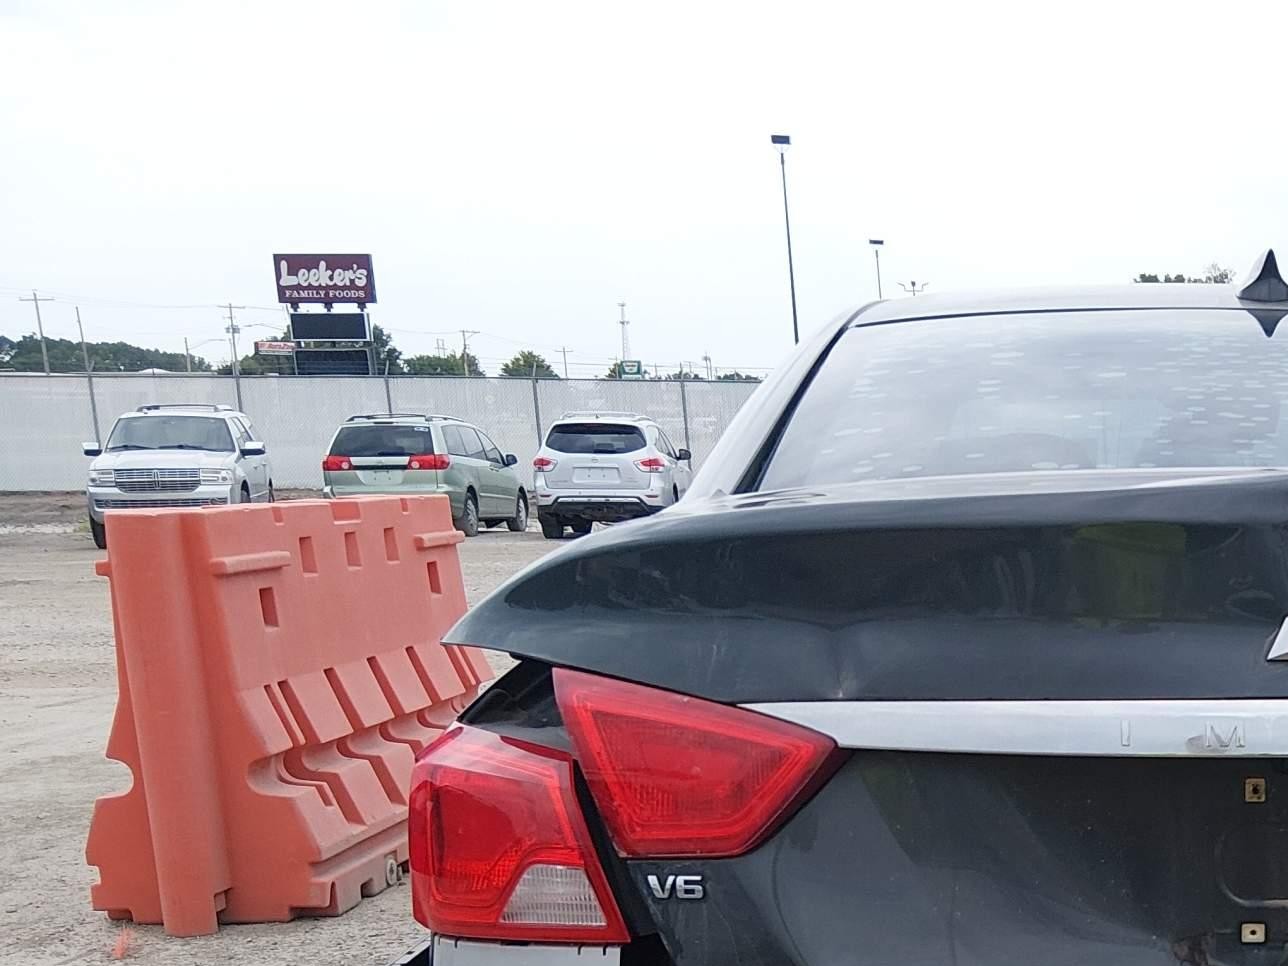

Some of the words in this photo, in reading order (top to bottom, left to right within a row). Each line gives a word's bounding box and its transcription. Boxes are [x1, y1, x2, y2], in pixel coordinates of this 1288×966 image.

[279, 260, 367, 286] Leeker's
[285, 290, 326, 298] FAMILY
[328, 290, 365, 298] FOODS
[647, 875, 704, 899] V6
